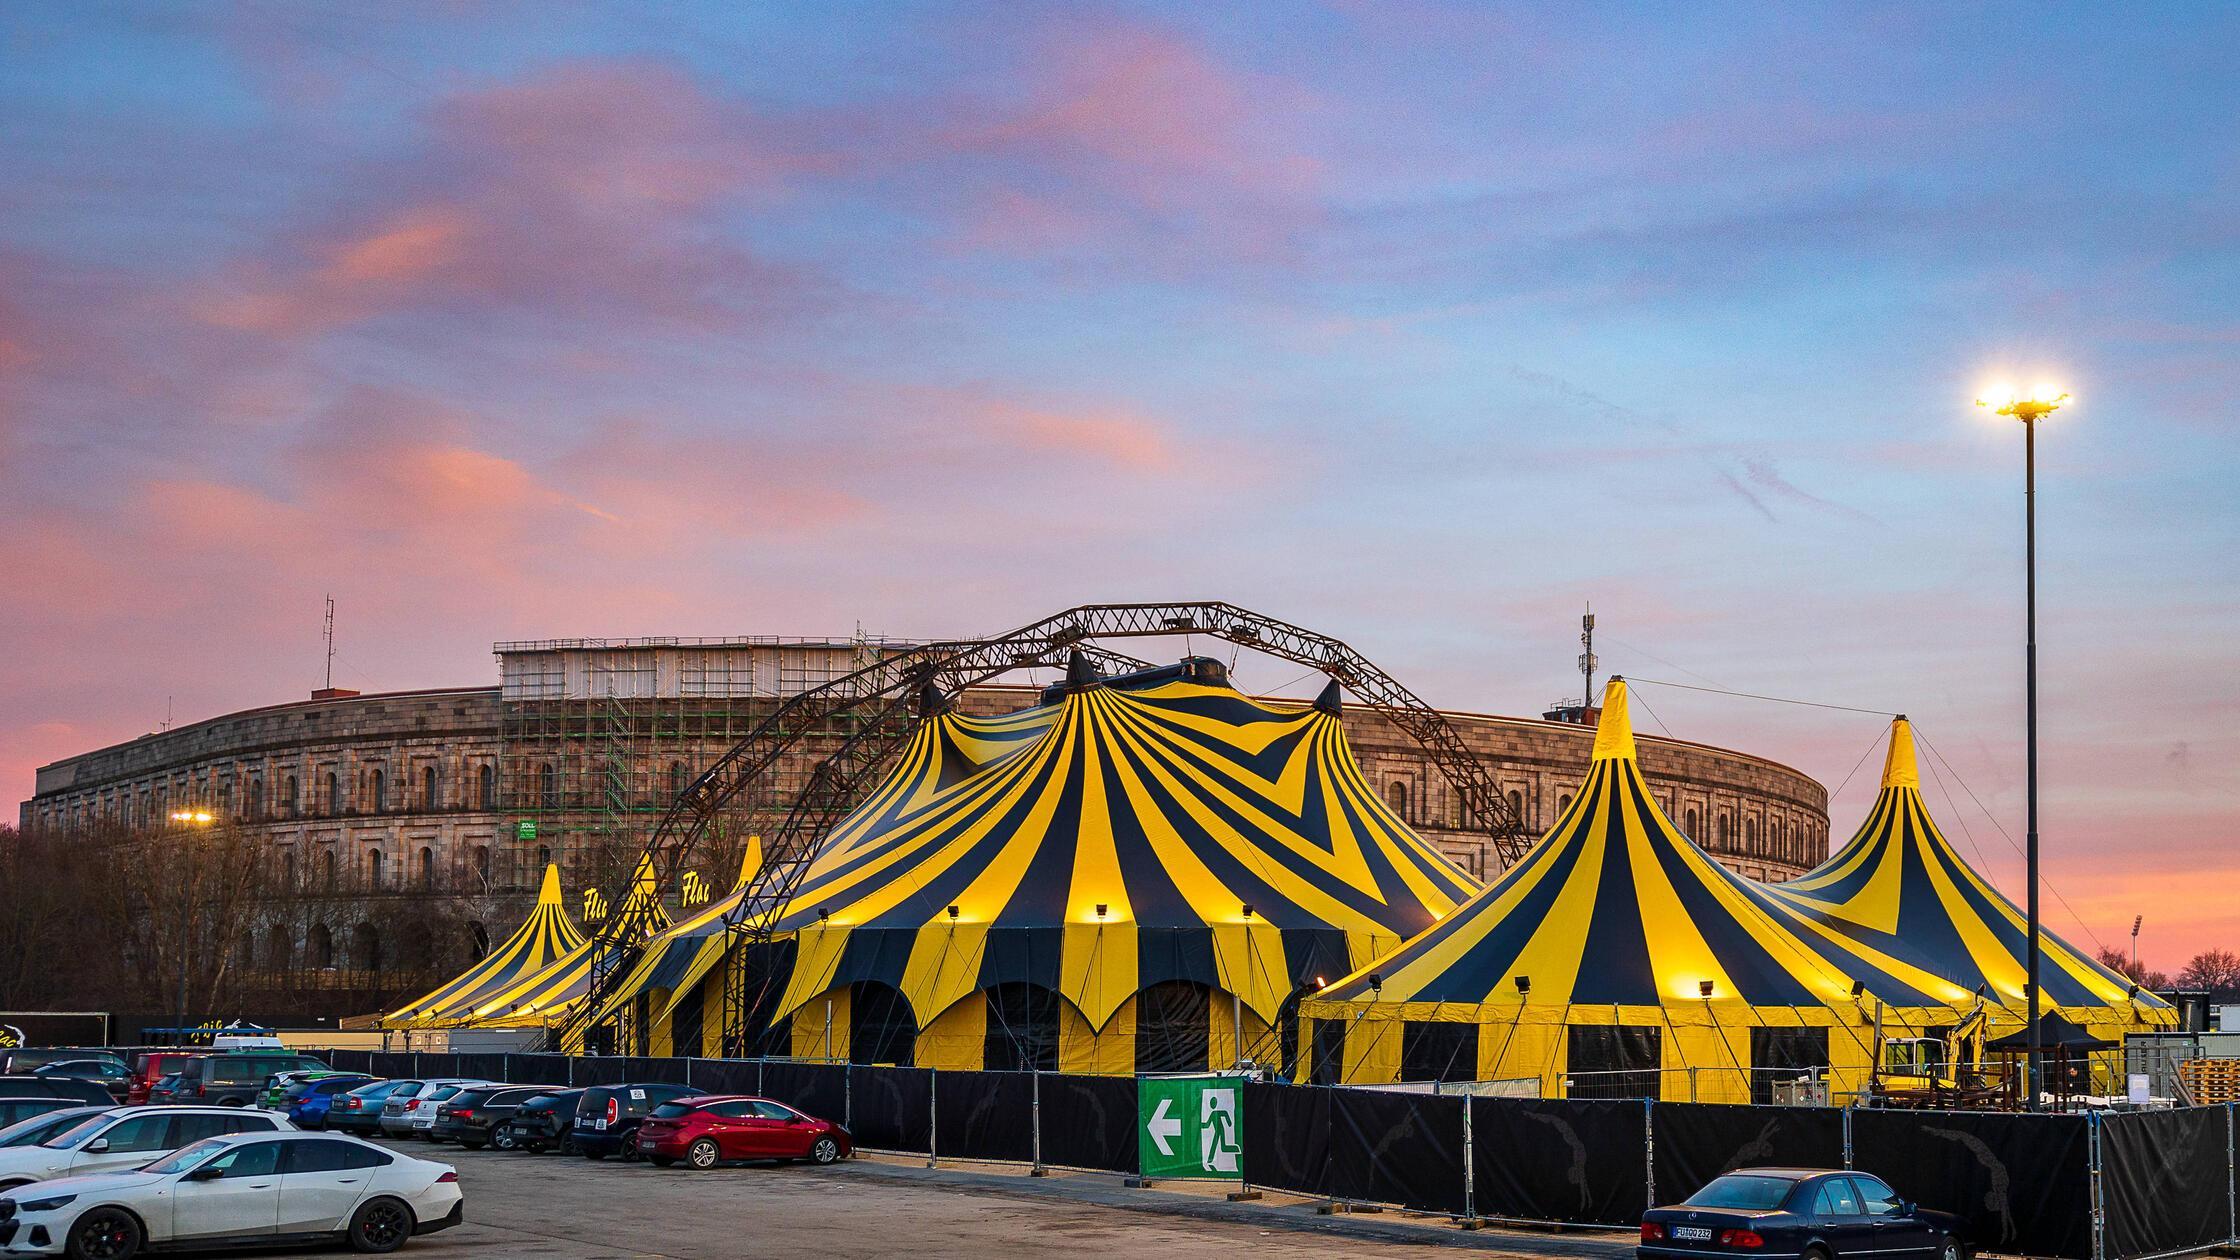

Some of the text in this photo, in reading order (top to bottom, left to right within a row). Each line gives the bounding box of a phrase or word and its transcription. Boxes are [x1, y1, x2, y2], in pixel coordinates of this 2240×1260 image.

[584, 870, 710, 922] Flic Flac
[1698, 1229, 1711, 1238] 232
